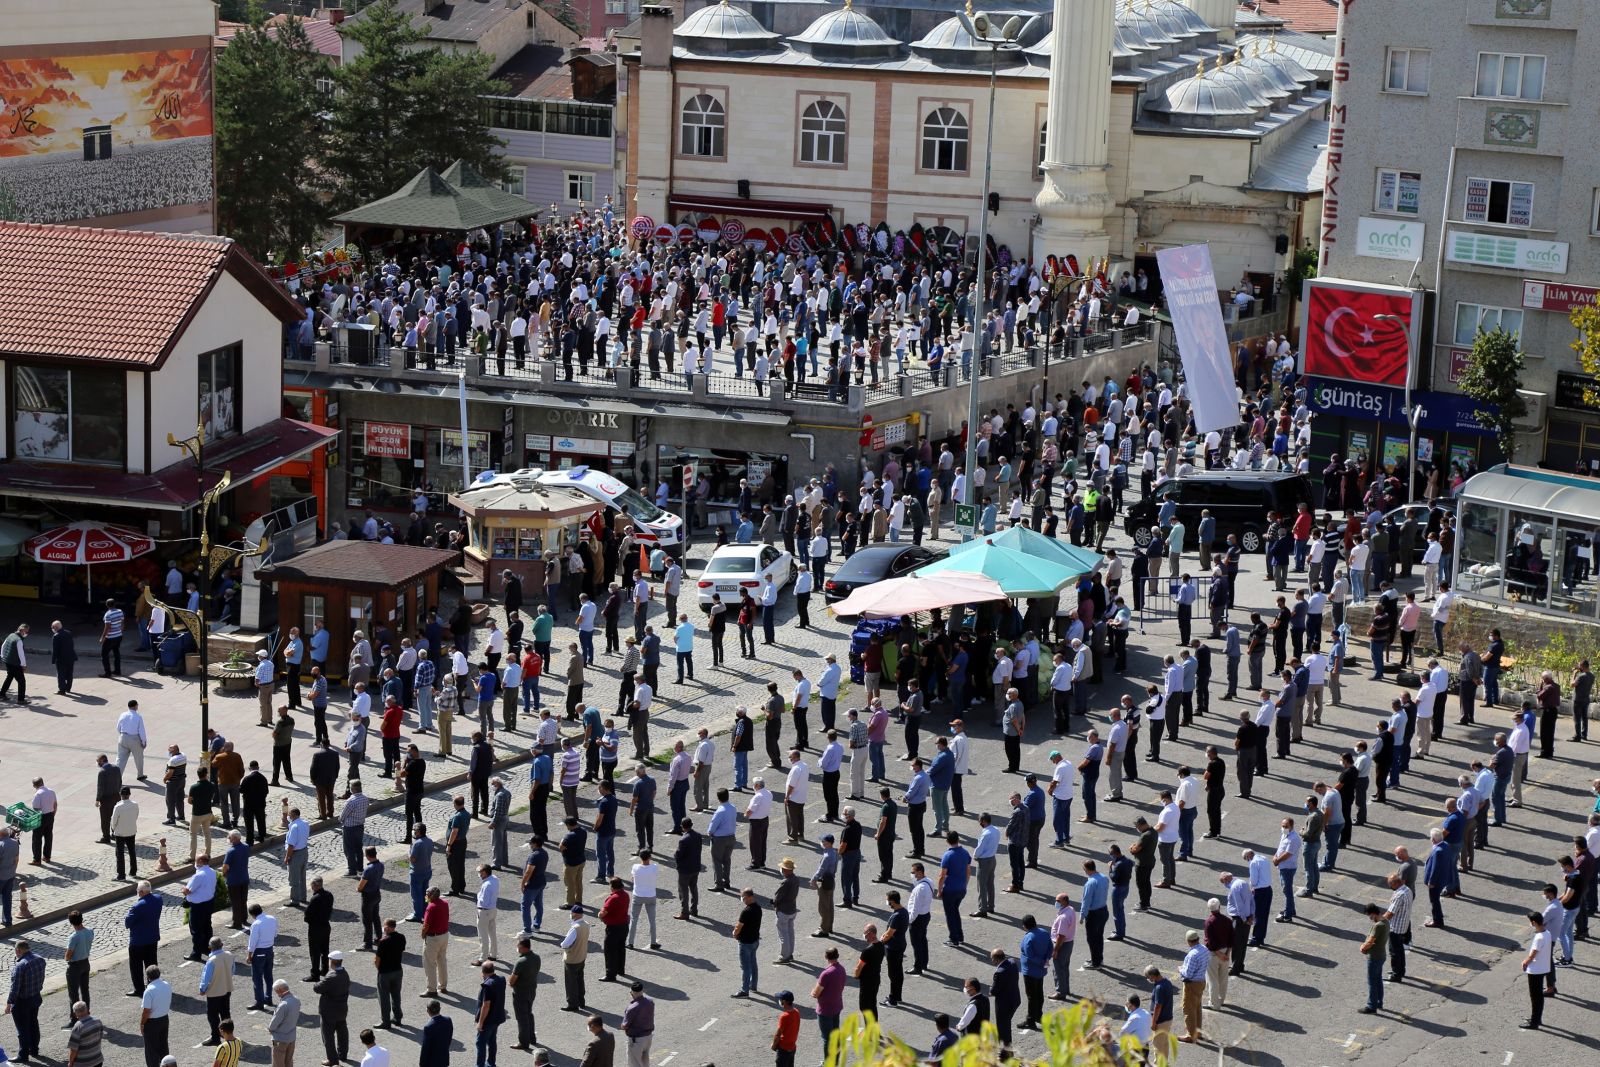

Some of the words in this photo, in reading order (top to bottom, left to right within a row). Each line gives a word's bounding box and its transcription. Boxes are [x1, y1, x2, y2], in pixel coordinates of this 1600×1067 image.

[1321, 104, 1348, 266] MERKEZİ
[1401, 192, 1418, 200] HDI
[1510, 217, 1530, 225] ERGO
[1546, 285, 1568, 301] İLİM
[1320, 387, 1383, 416] güntaş
[371, 425, 404, 436] BÜYÜK
[375, 436, 401, 444] SEZON
[47, 552, 71, 560] ALGIDA
[92, 551, 118, 560] ALGIDA
